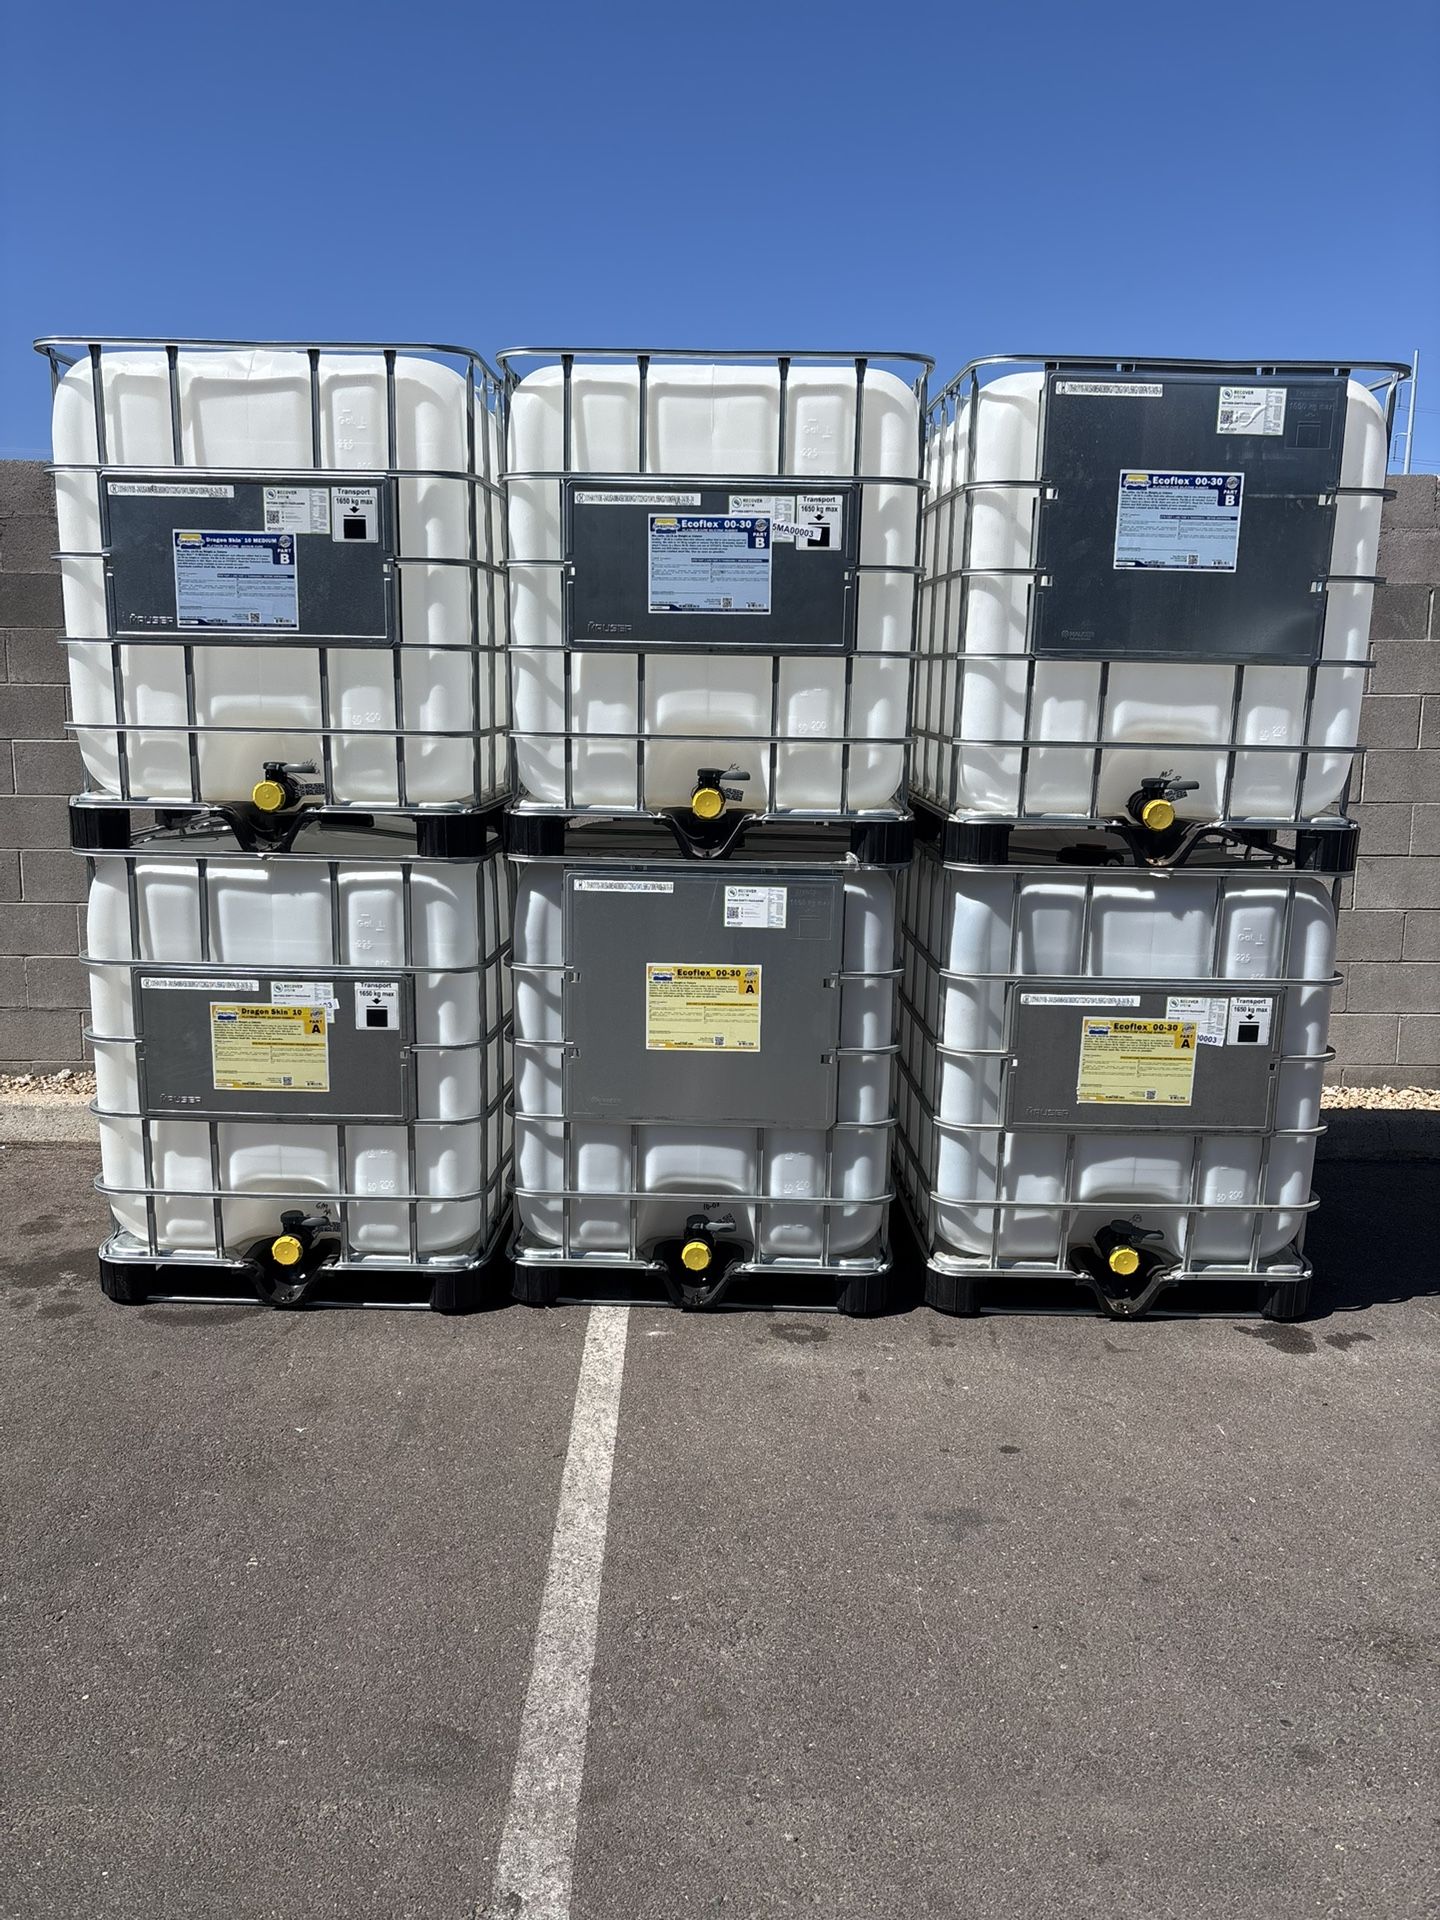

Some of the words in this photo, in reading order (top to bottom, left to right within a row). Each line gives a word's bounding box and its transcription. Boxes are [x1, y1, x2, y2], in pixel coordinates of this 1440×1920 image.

[1195, 477, 1223, 486] 00-30
[338, 488, 370, 496] Transport
[351, 498, 359, 506] kg
[1225, 495, 1235, 506] B
[816, 505, 824, 513] kg
[724, 520, 752, 528] 00-30
[772, 523, 814, 537] 5MA00003
[755, 538, 765, 548] B
[280, 553, 290, 564] B
[745, 985, 755, 994] A
[241, 1008, 269, 1016] Dragon
[1248, 1006, 1255, 1014] kg
[311, 1024, 321, 1034] A
[1181, 1039, 1190, 1048] A
[1229, 1190, 1243, 1200] 200
